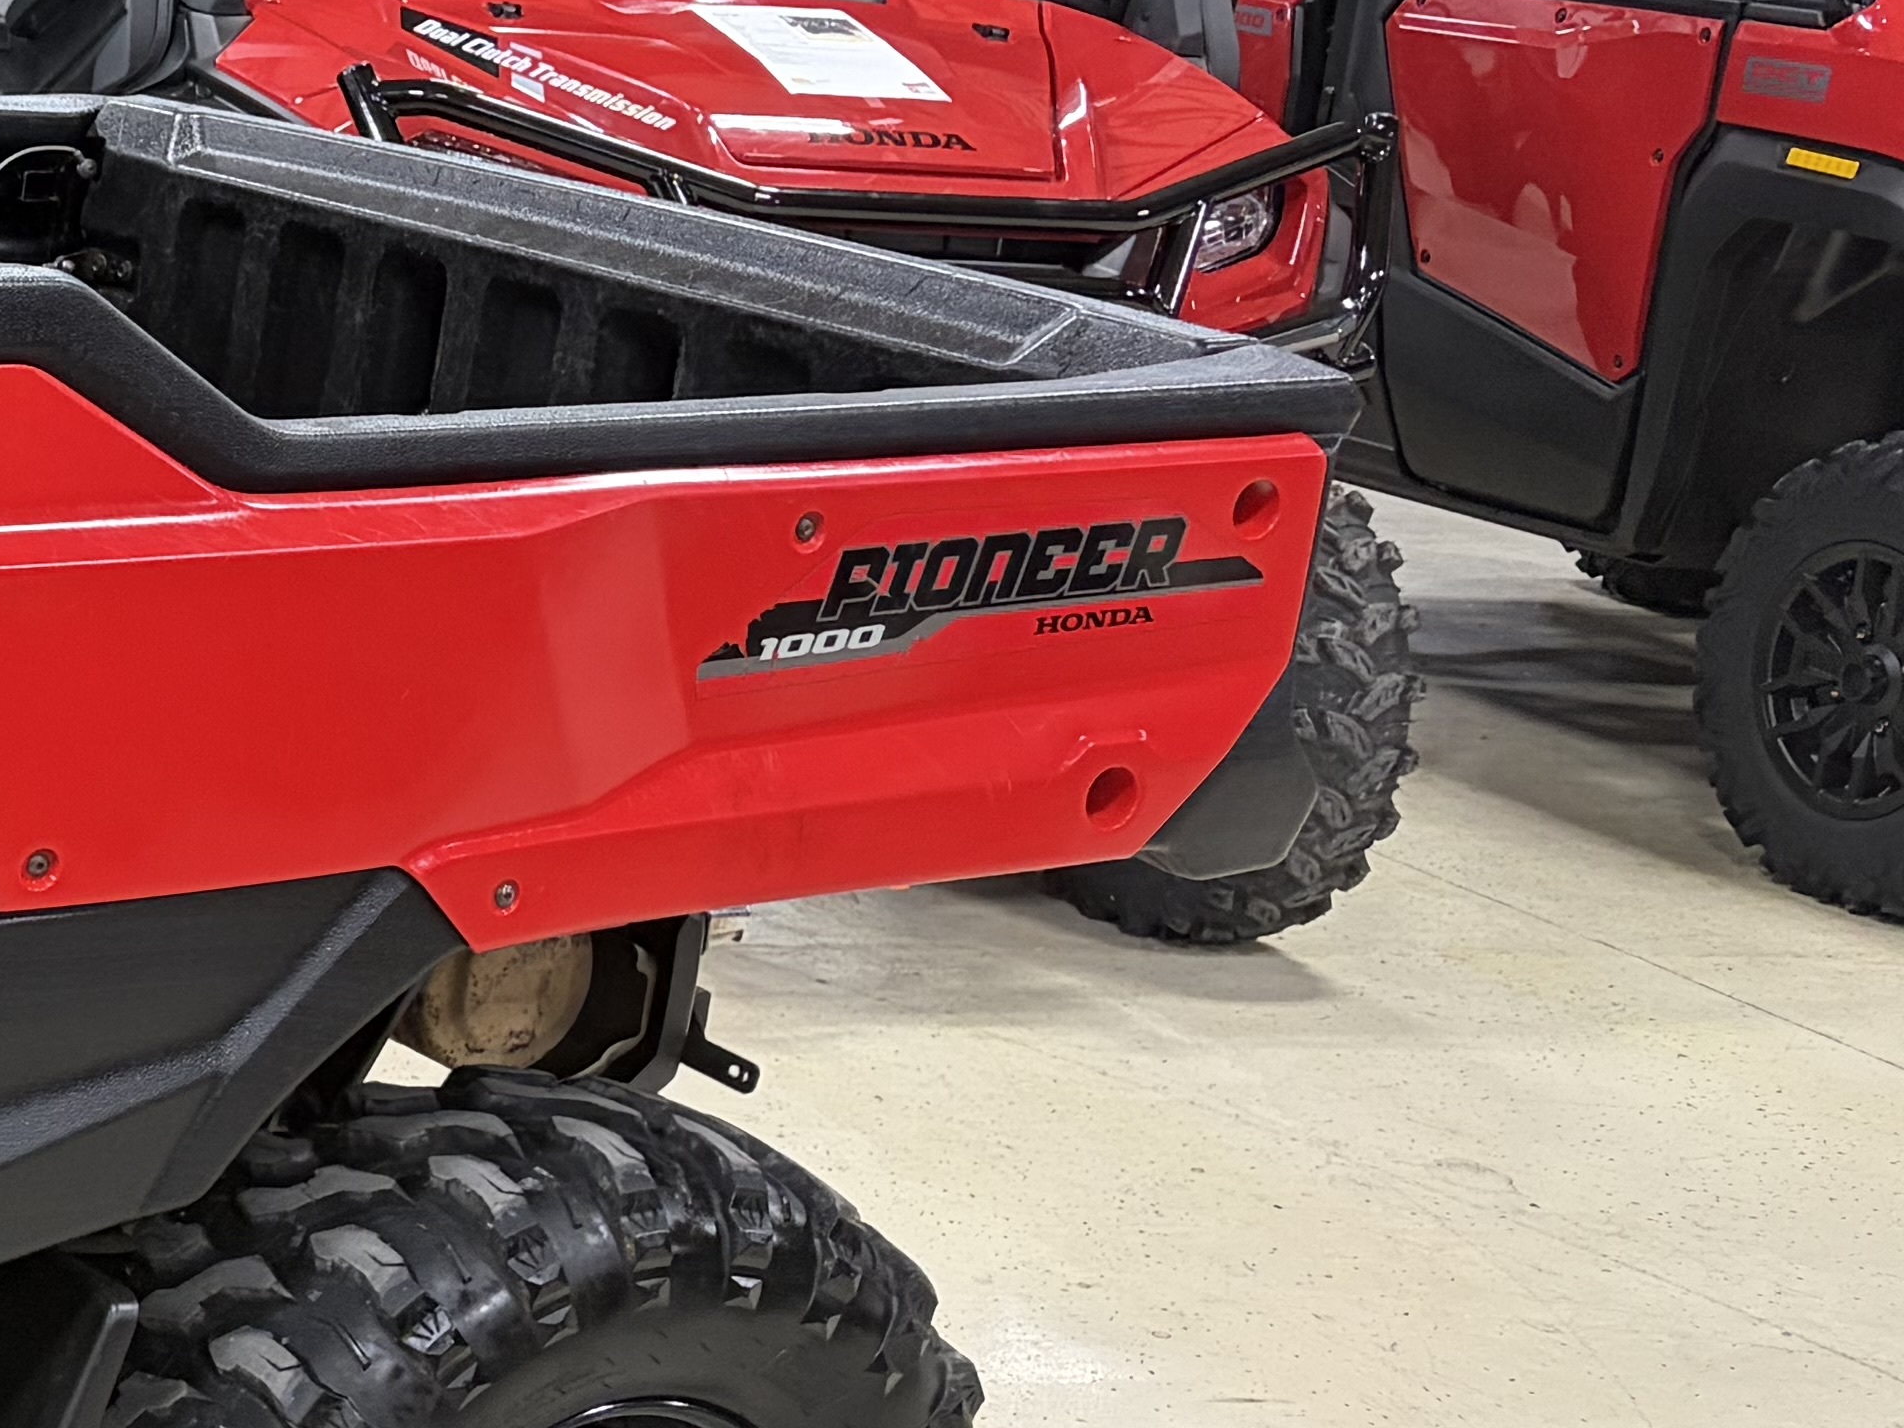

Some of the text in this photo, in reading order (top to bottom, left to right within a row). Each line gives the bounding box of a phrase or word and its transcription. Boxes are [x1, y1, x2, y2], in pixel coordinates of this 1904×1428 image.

[412, 18, 677, 131] Dual Clutch Transmission
[807, 128, 977, 152] HONDA
[816, 515, 1189, 622] PIONEER
[1033, 605, 1155, 637] HONDA
[758, 623, 886, 662] 1000
